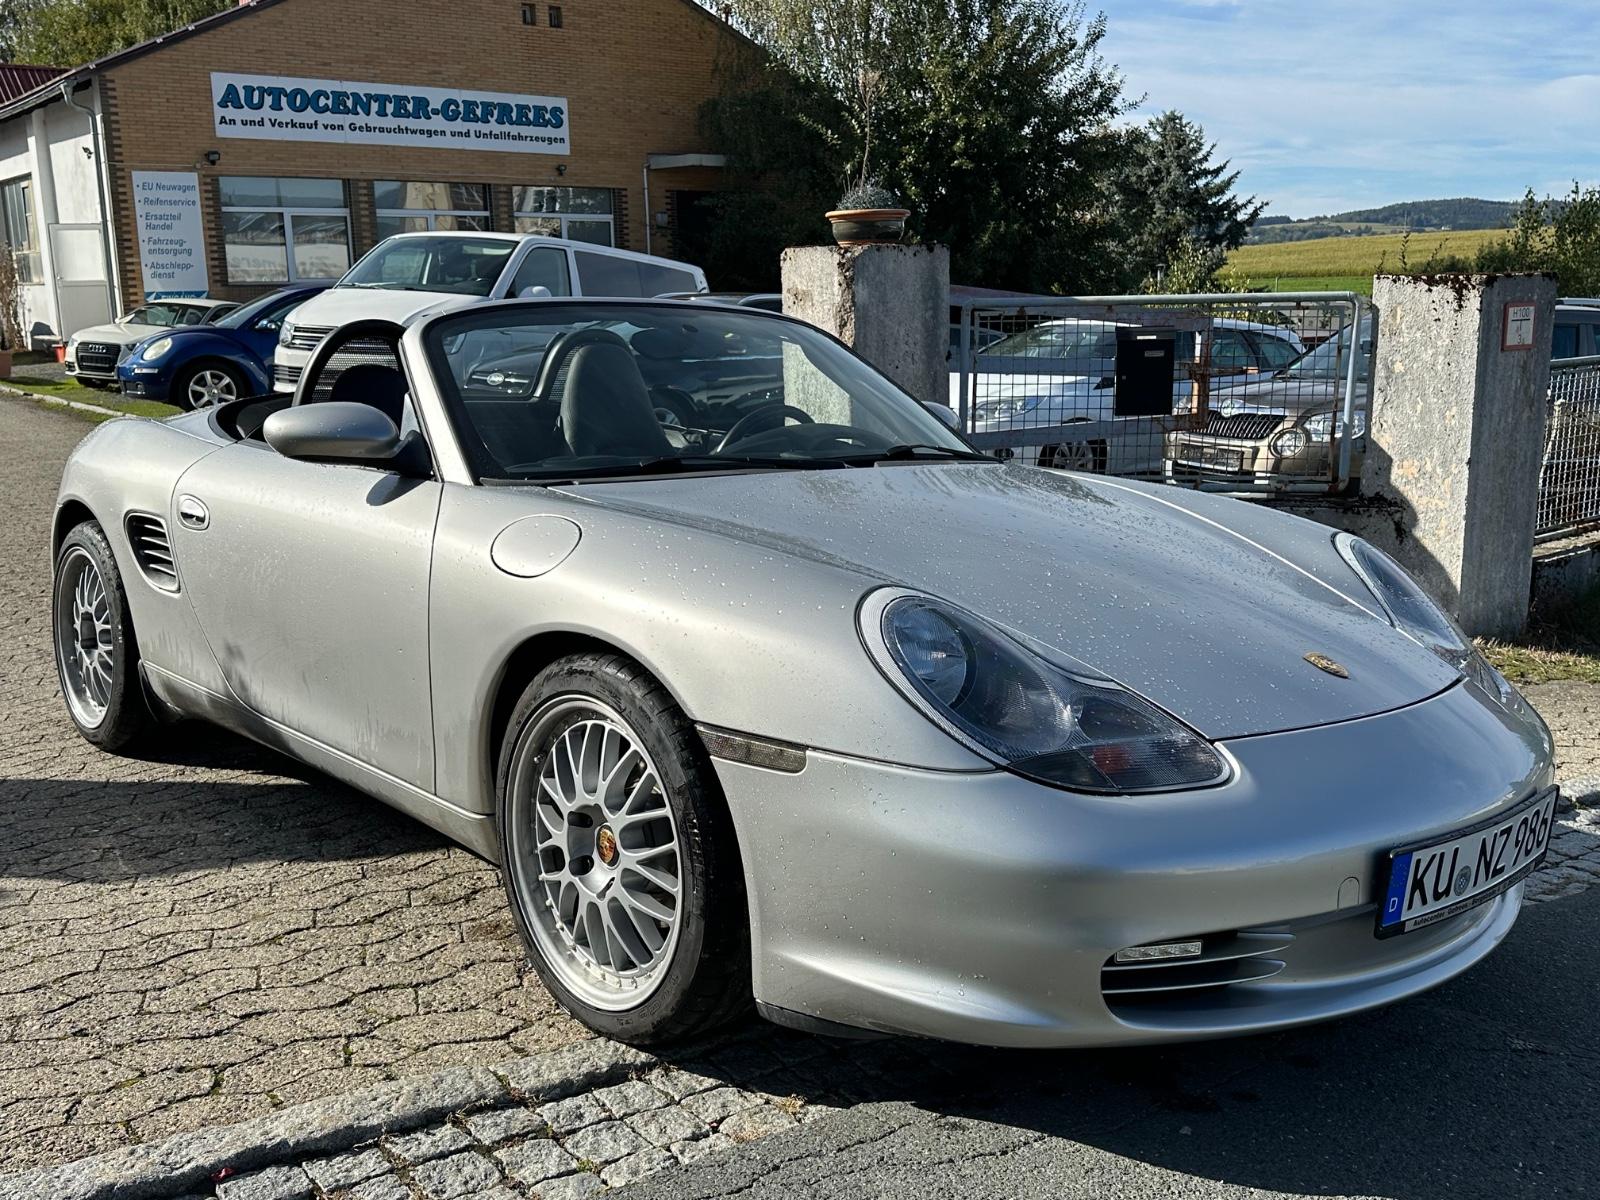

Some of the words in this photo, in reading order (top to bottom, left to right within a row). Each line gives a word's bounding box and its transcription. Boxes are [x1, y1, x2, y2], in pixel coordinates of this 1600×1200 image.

[217, 83, 564, 129] AUTOCENTER-GEFREES
[218, 116, 236, 126] An
[241, 117, 265, 127] und
[268, 118, 319, 130] Verkauf
[349, 122, 447, 138] Gebrauchtwagen
[450, 129, 471, 139] und
[474, 130, 566, 146] Unfallfahrzeugen
[142, 182, 154, 191] EU
[155, 182, 196, 193] Neuwagen
[143, 197, 196, 207] Reifenservice
[145, 212, 182, 221] Ersatzteil
[145, 222, 173, 231] Handel
[147, 237, 187, 248] Fahrzeug-
[148, 248, 192, 257] entsorgung
[149, 261, 194, 271] Abschlepp-
[150, 271, 175, 279] dienst
[1407, 847, 1460, 911] KU
[1388, 897, 1398, 913] D
